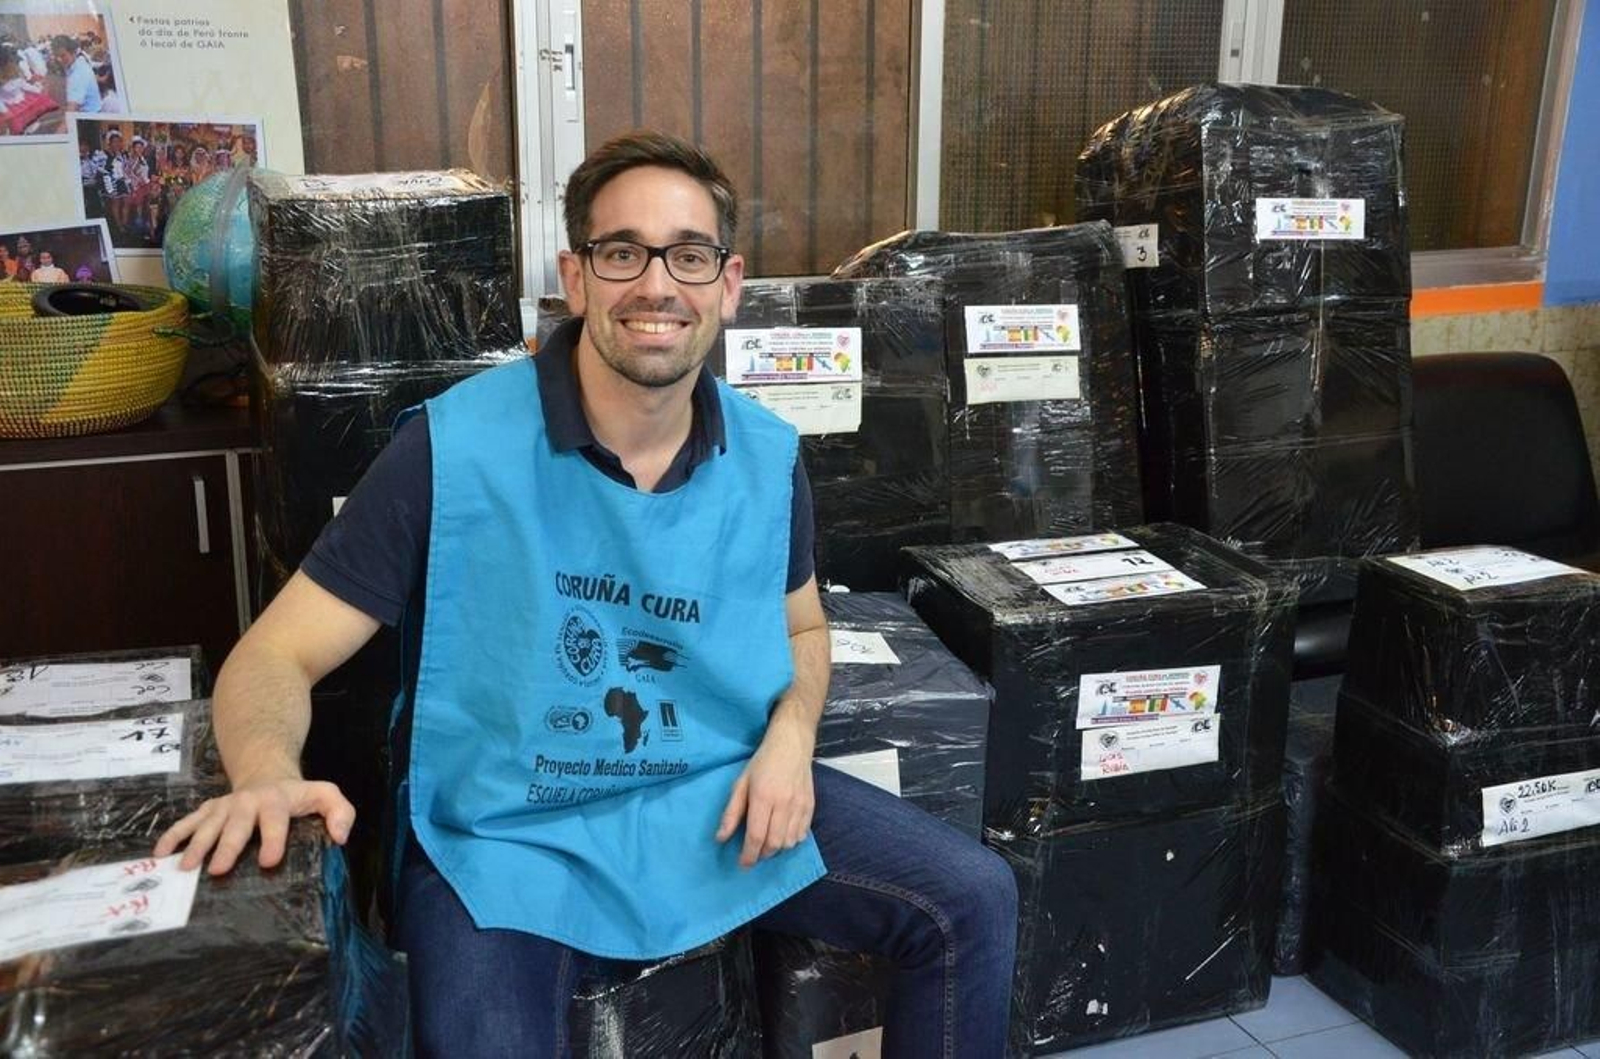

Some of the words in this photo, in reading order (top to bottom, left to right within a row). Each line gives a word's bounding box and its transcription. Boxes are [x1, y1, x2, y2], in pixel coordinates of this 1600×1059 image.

[137, 16, 171, 26] Festas
[174, 18, 210, 27] patrias
[138, 28, 152, 37] do
[177, 29, 189, 37] de
[219, 29, 249, 38] fronte
[151, 39, 176, 48] local
[181, 40, 193, 48] de
[197, 40, 225, 49] GAIA
[1136, 245, 1148, 262] 3
[555, 570, 631, 606] CORUÑA
[641, 593, 700, 624] CURA
[535, 754, 591, 778] Proyecto
[593, 758, 637, 777] Medico
[638, 758, 690, 776] Sanitario
[526, 783, 576, 804] ESCUELA
